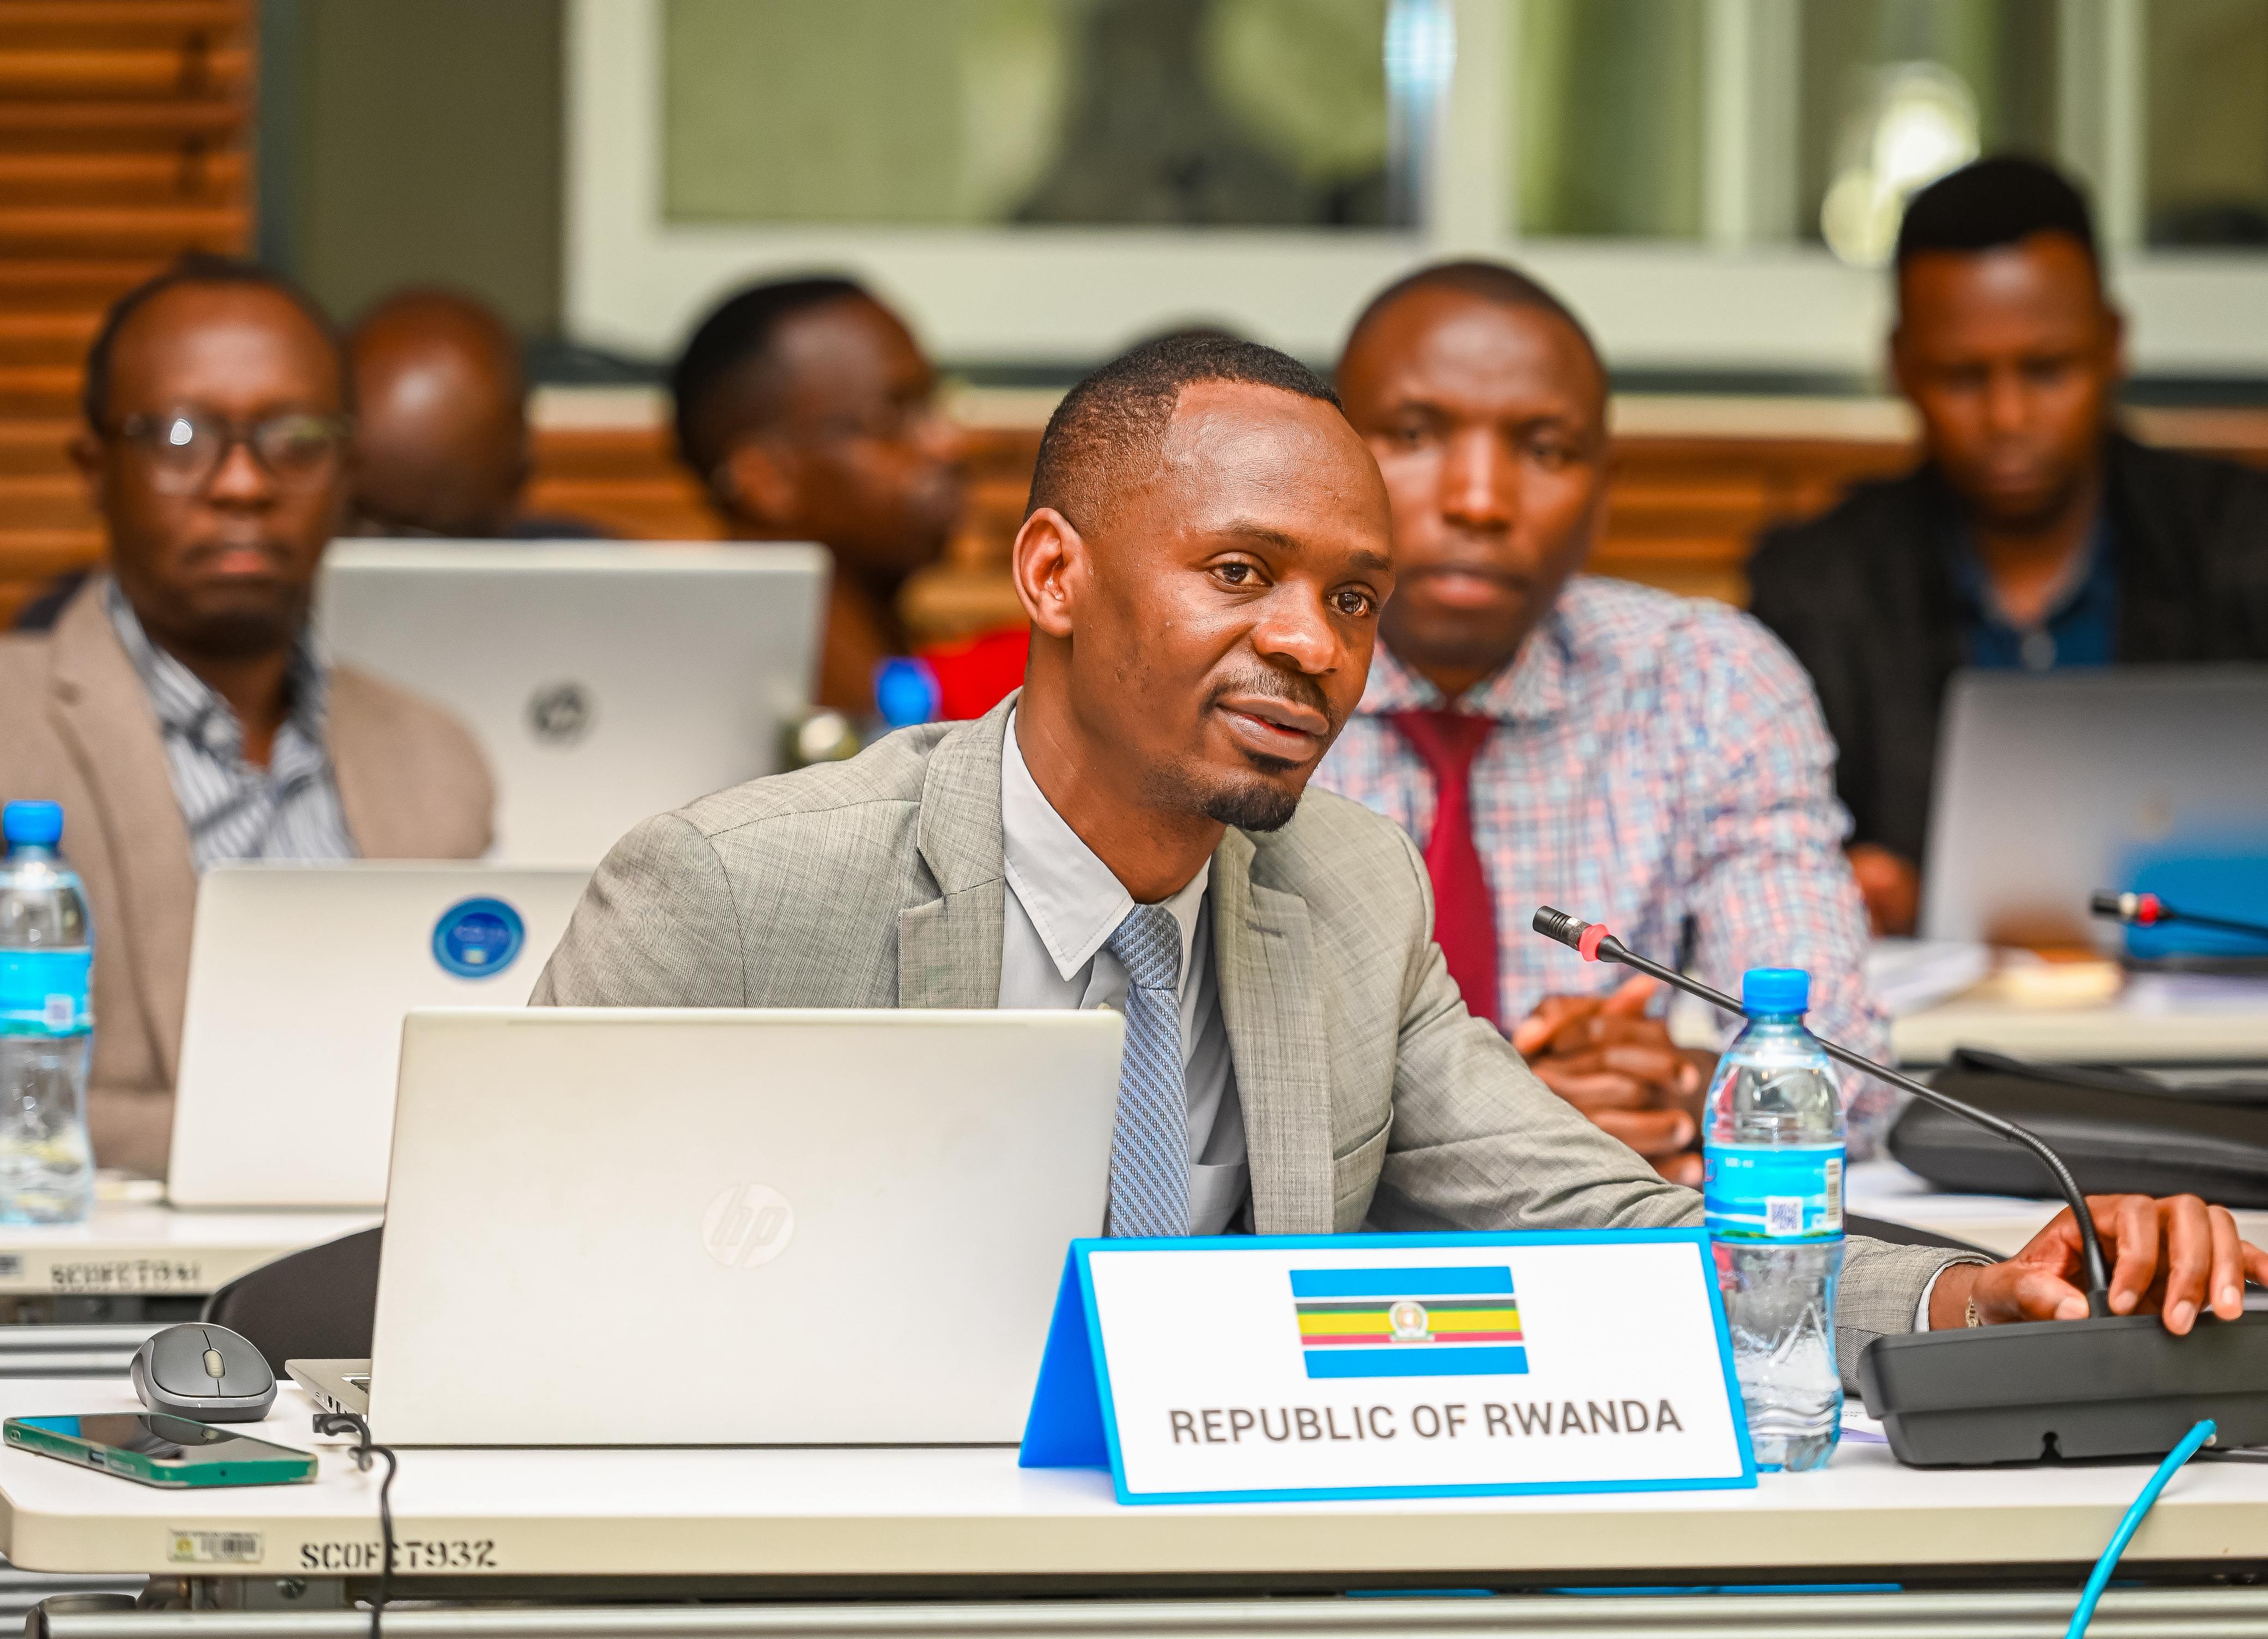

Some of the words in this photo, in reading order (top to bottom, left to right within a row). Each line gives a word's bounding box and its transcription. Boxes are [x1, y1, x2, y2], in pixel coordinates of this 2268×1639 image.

[705, 1183, 791, 1269] hp
[1168, 1406, 1396, 1443] REPUBLIC
[1412, 1404, 1466, 1438] OF
[1483, 1399, 1684, 1436] RWANDA
